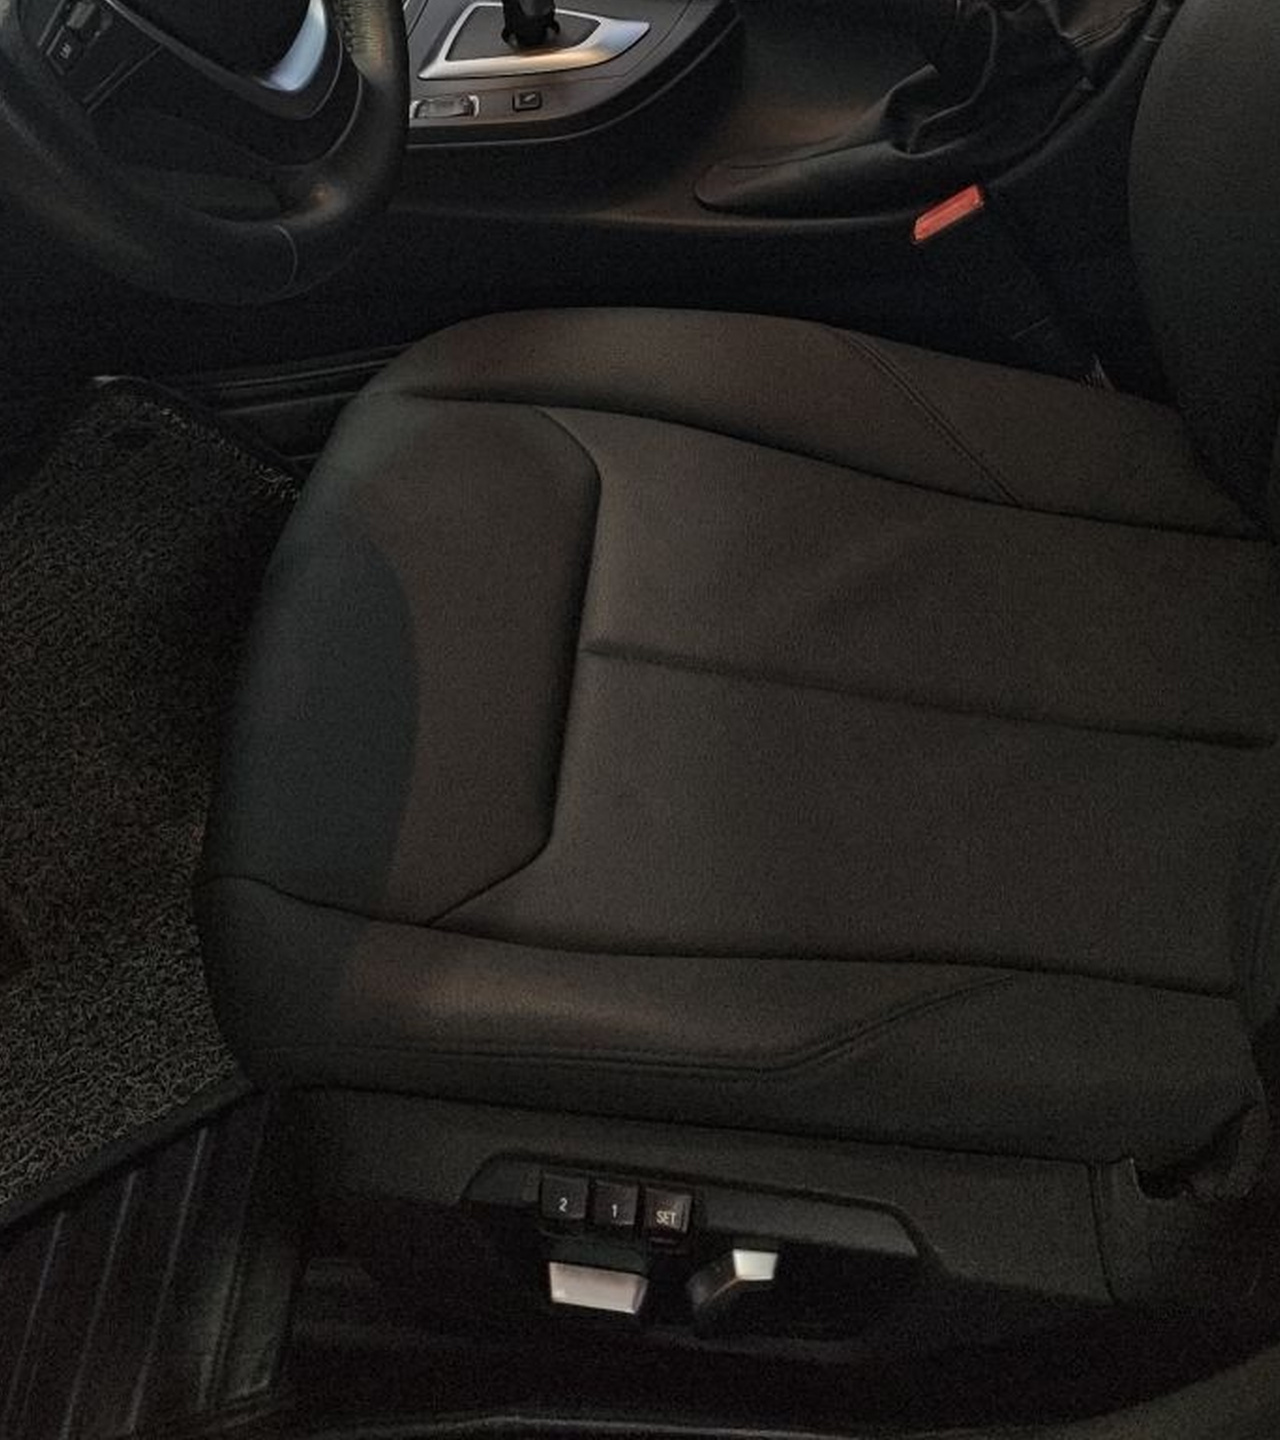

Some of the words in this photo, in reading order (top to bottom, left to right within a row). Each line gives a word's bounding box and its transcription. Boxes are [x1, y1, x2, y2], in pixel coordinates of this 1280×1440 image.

[558, 1197, 568, 1213] 2
[610, 1203, 618, 1219] 1
[656, 1210, 677, 1226] SET
